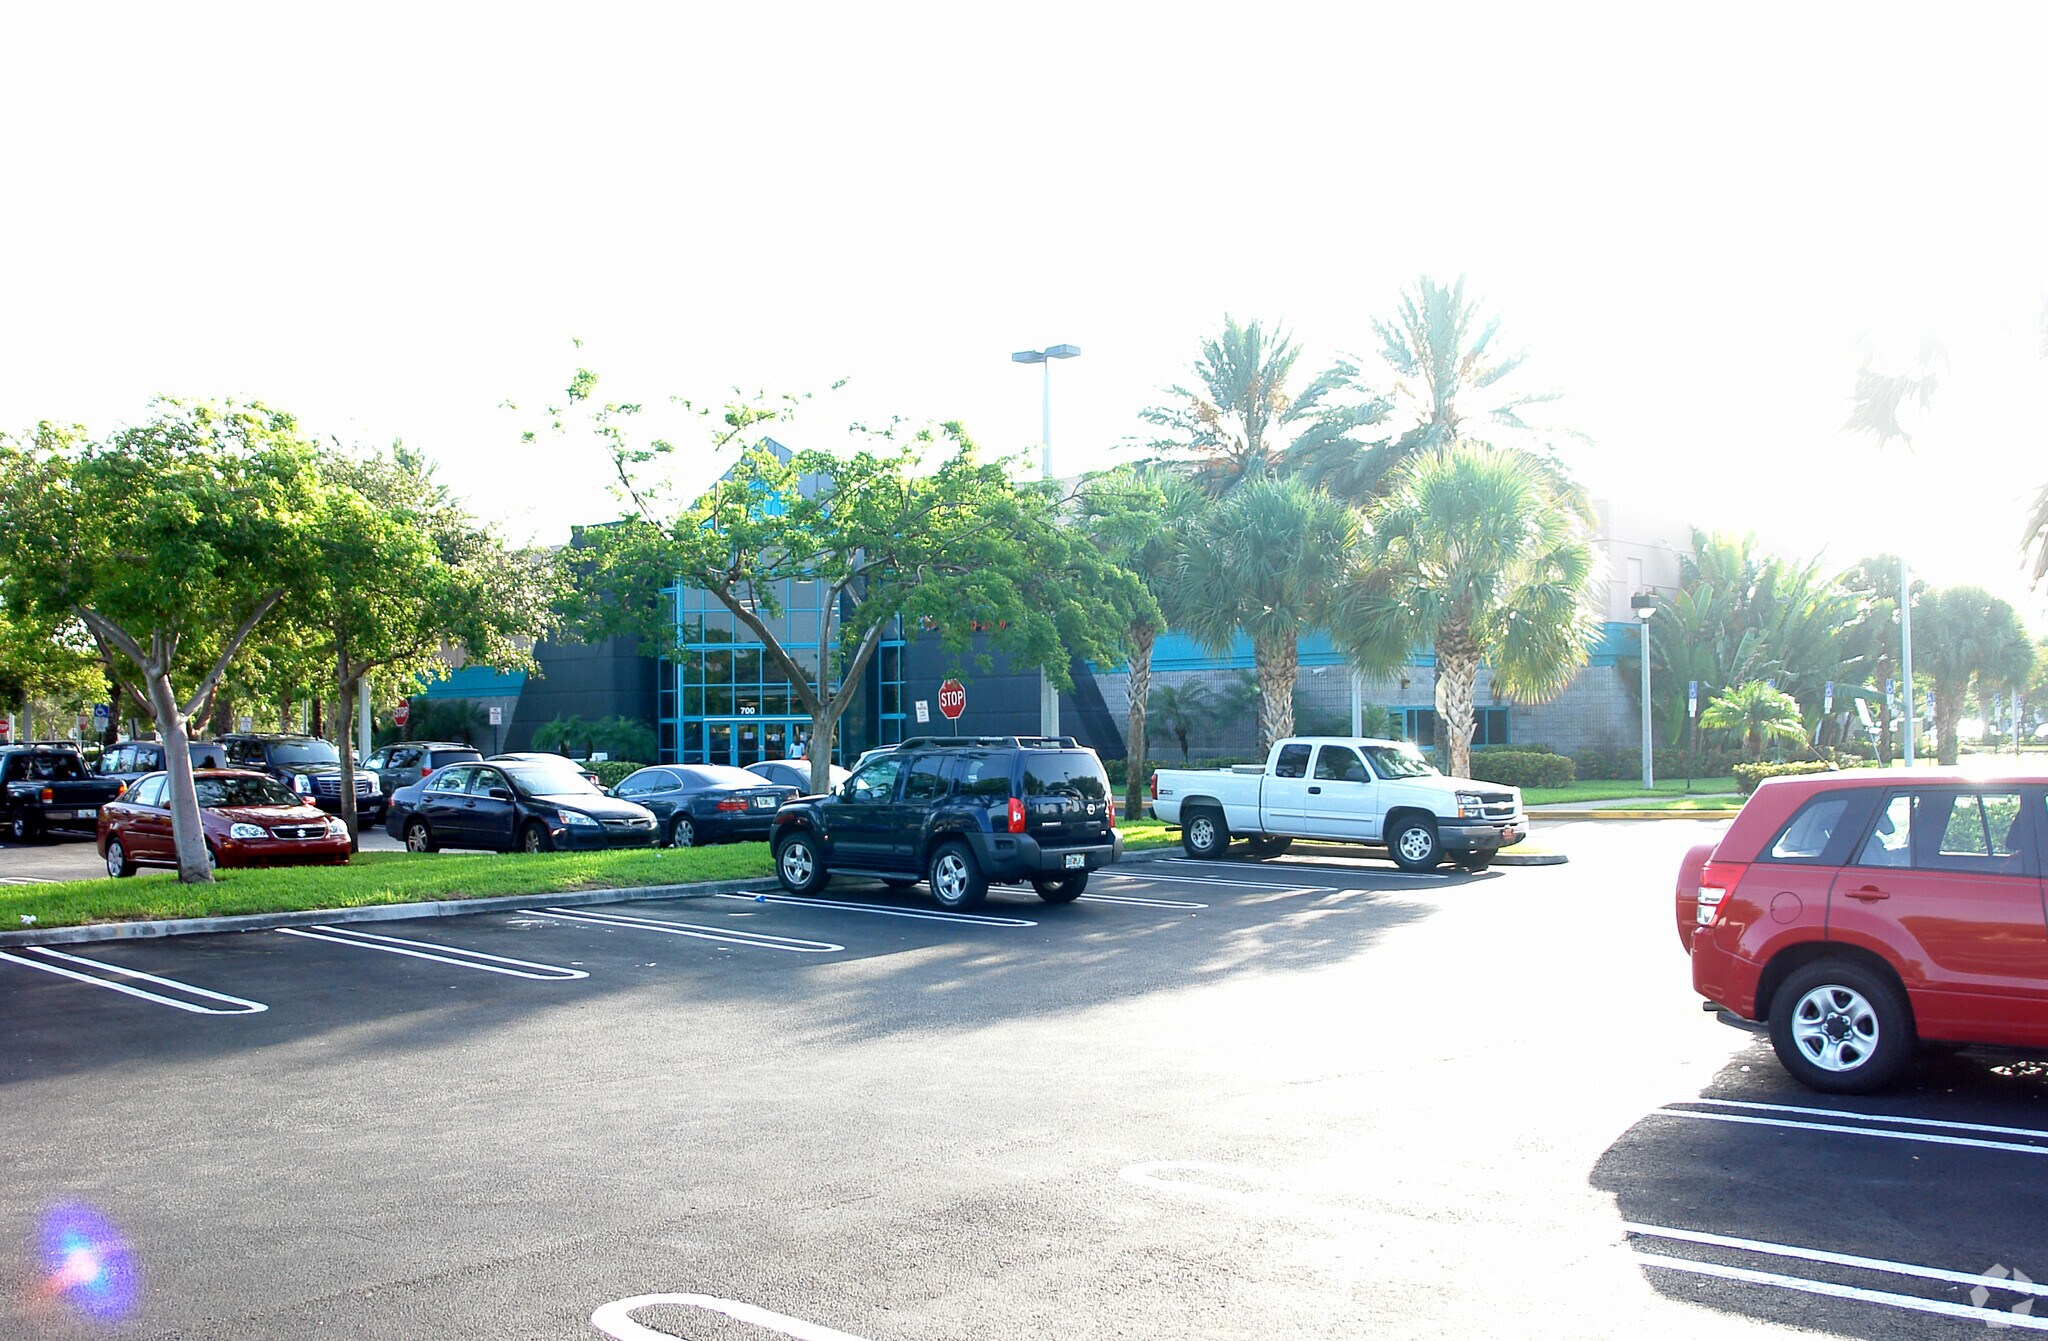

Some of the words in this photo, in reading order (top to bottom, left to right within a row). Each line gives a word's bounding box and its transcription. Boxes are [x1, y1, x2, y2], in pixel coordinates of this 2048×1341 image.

[941, 691, 963, 707] STOP
[395, 707, 408, 717] STOP
[740, 706, 755, 714] 700
